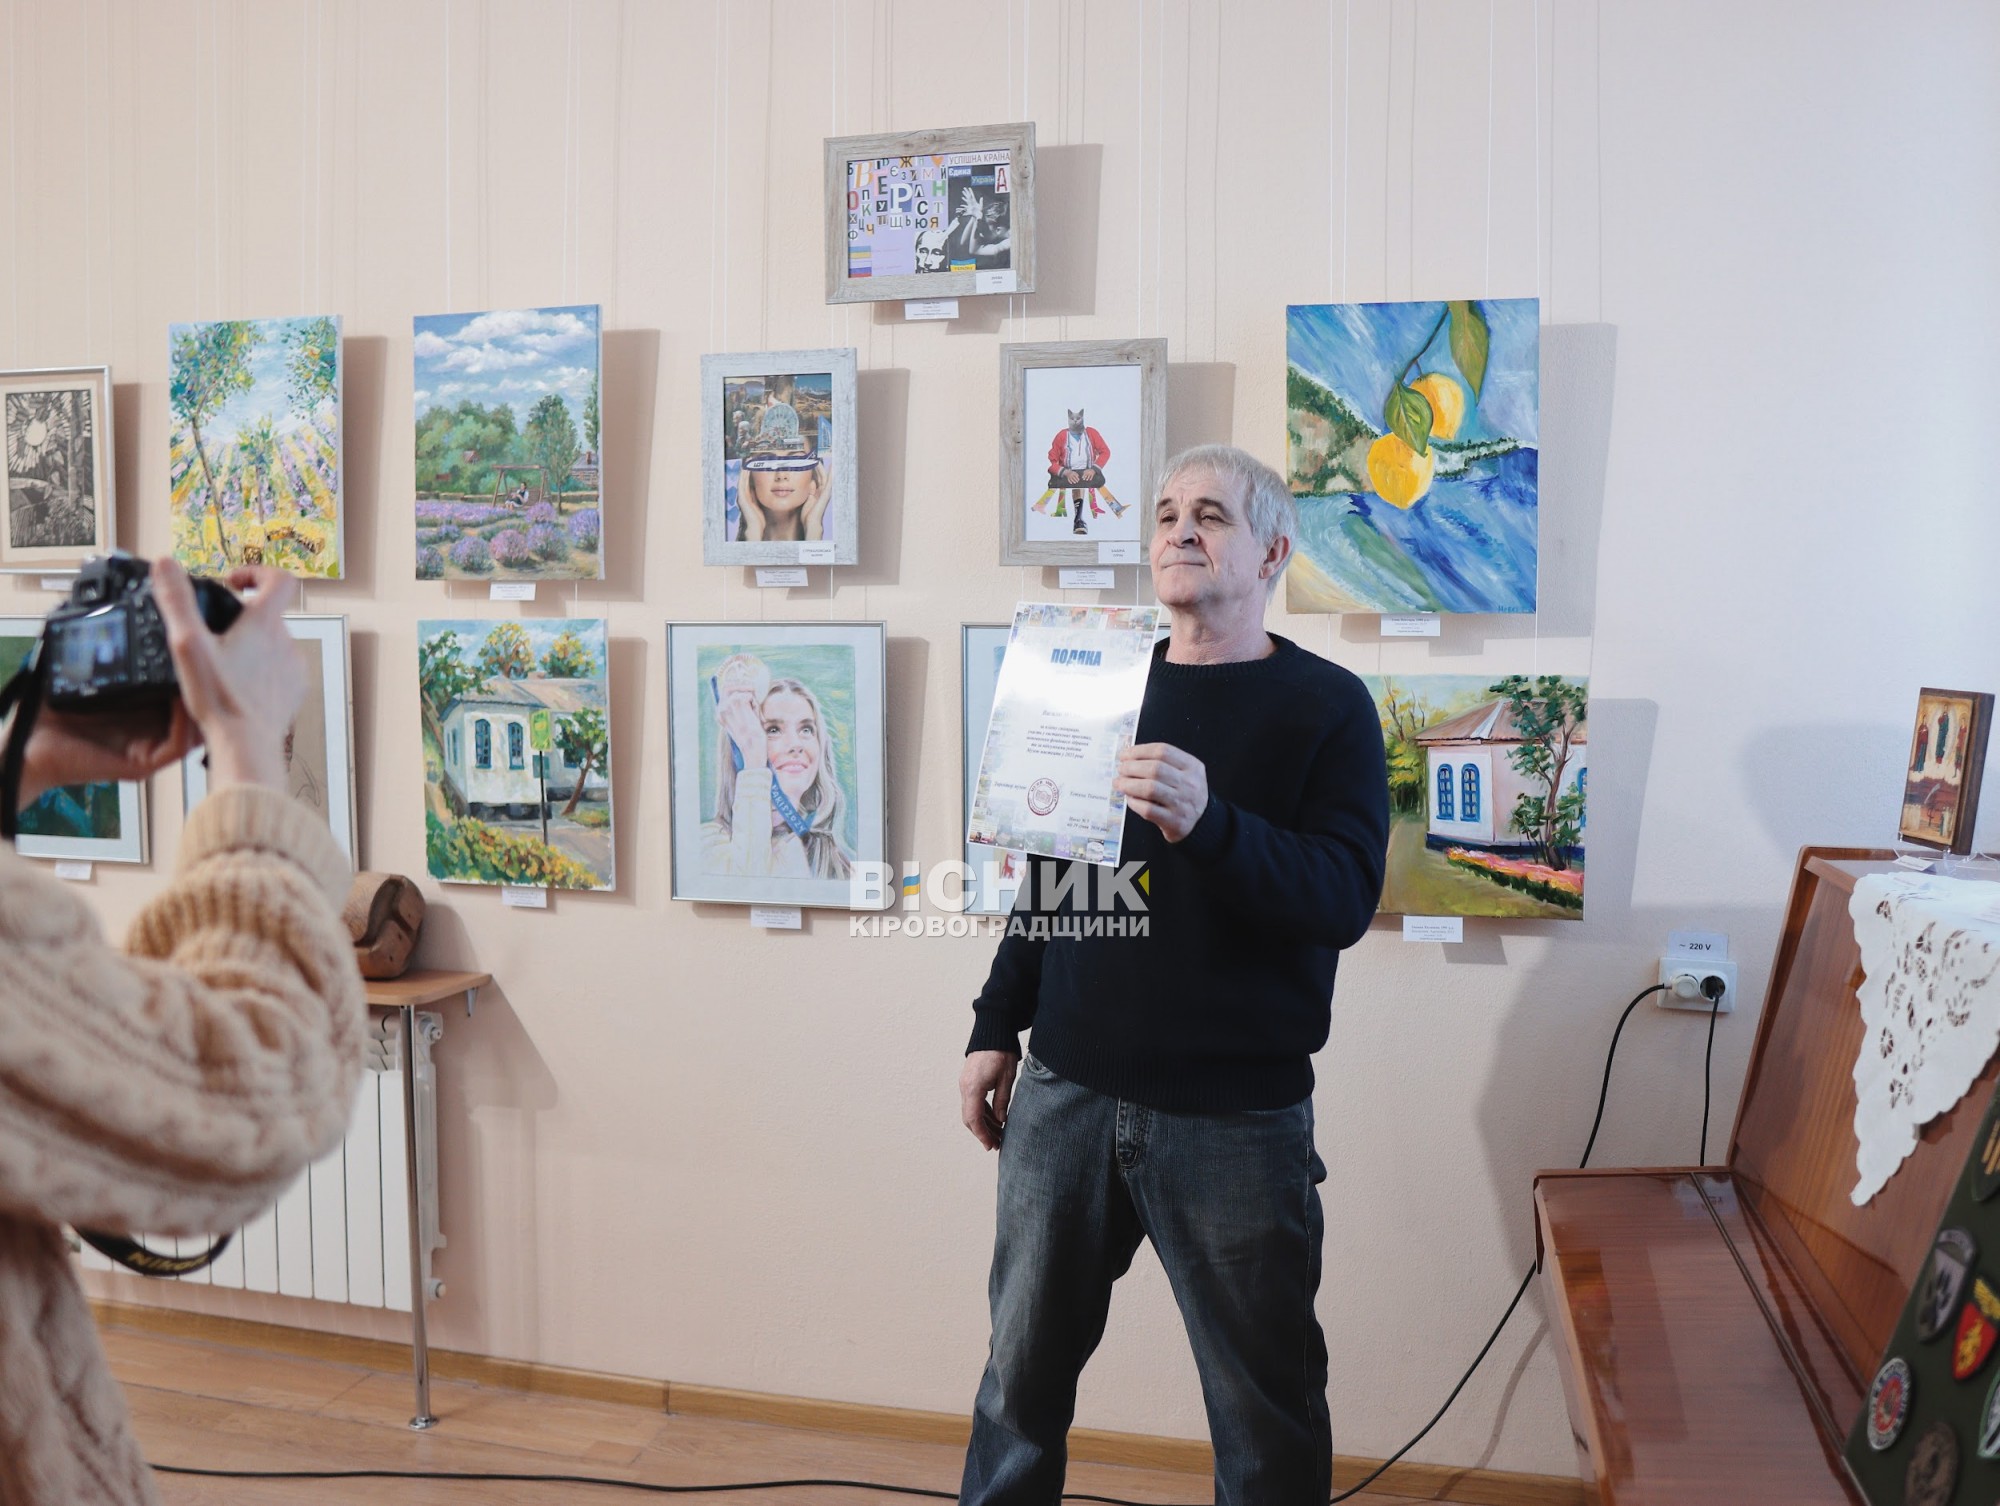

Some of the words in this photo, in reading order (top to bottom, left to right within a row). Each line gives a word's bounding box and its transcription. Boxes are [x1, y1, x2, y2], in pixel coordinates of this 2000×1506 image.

[949, 154, 982, 165] УСПІШНА
[983, 151, 1010, 163] КРАЇНА
[1050, 648, 1103, 667] ПОДЯКА
